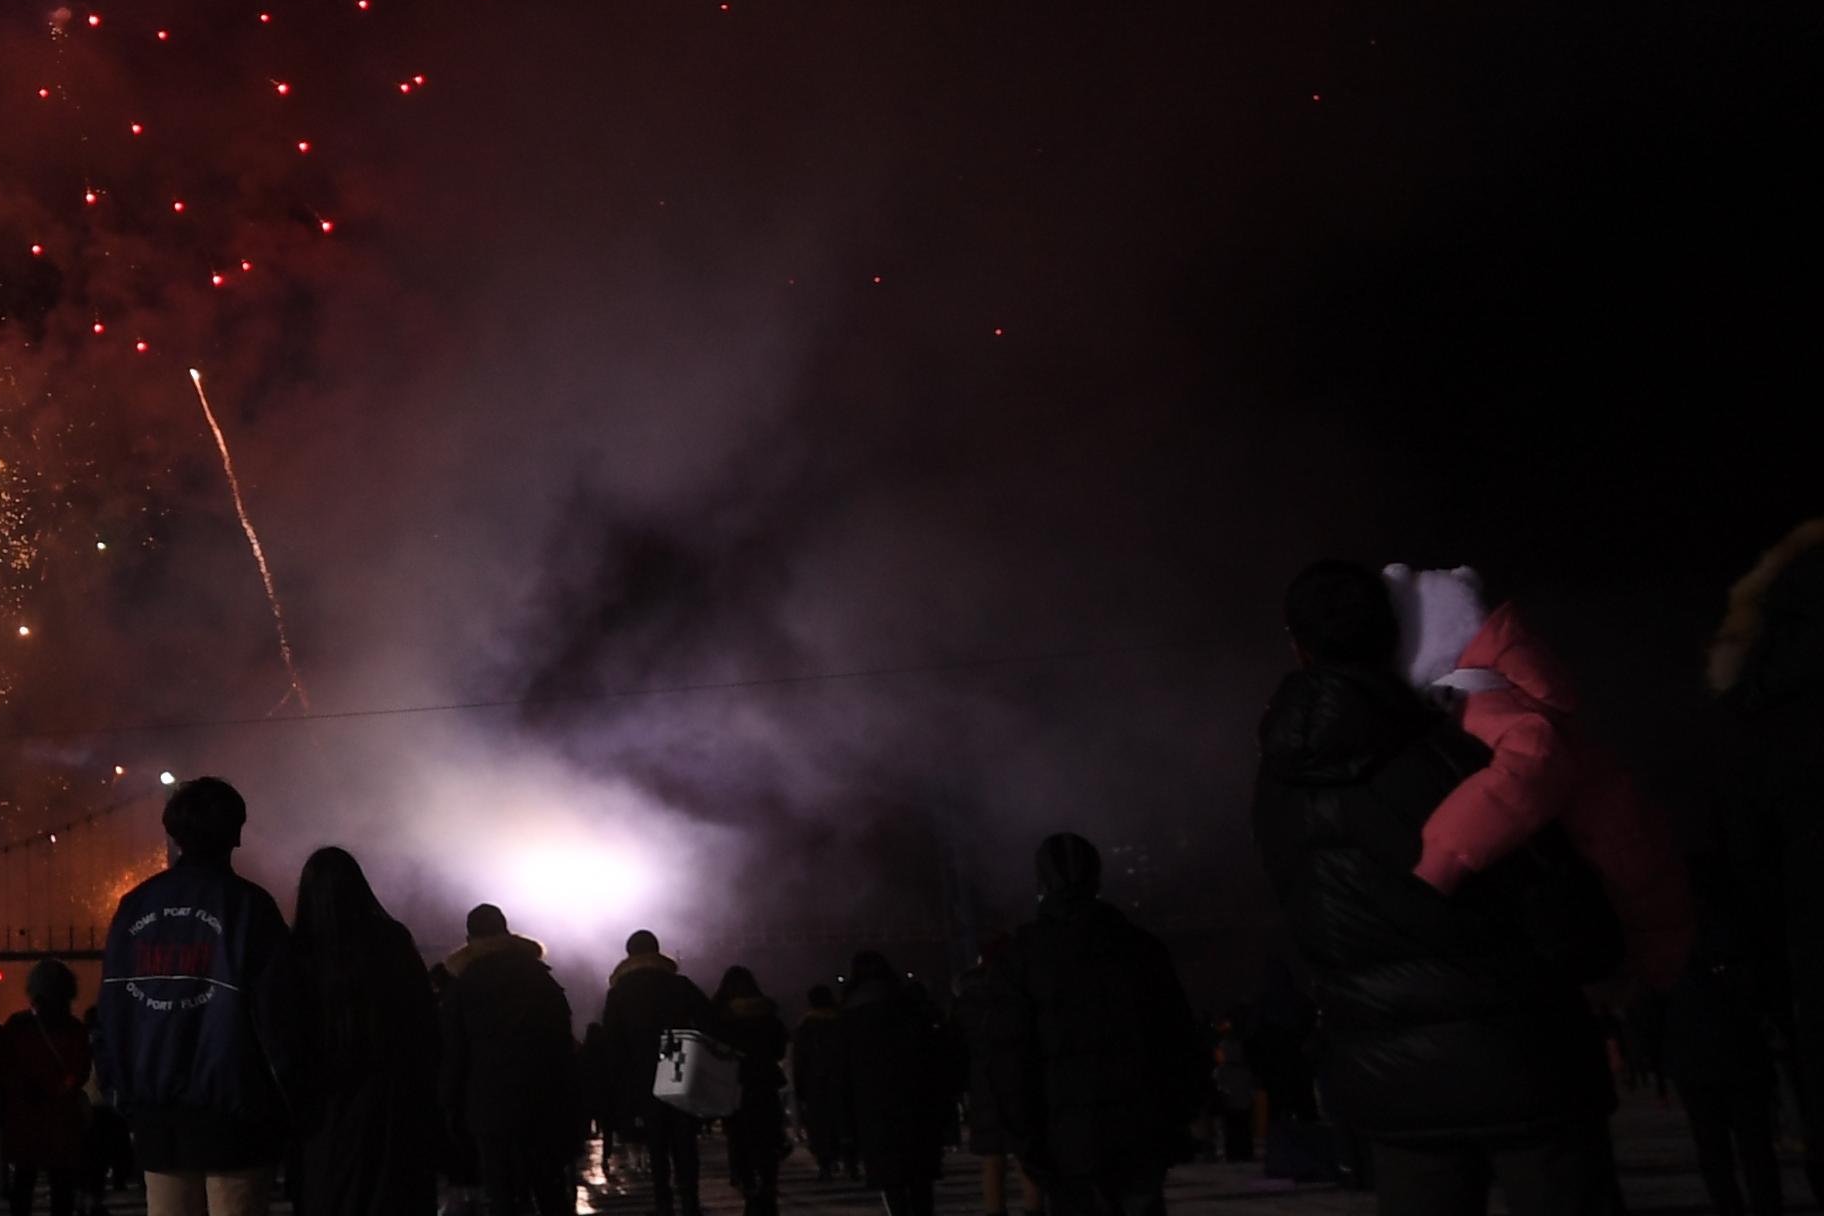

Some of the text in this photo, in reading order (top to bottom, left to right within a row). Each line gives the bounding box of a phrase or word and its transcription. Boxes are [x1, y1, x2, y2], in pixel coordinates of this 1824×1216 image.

[128, 907, 223, 936] HOME PORT FLIGH
[126, 982, 145, 1001] OUT
[146, 998, 173, 1010] PORT
